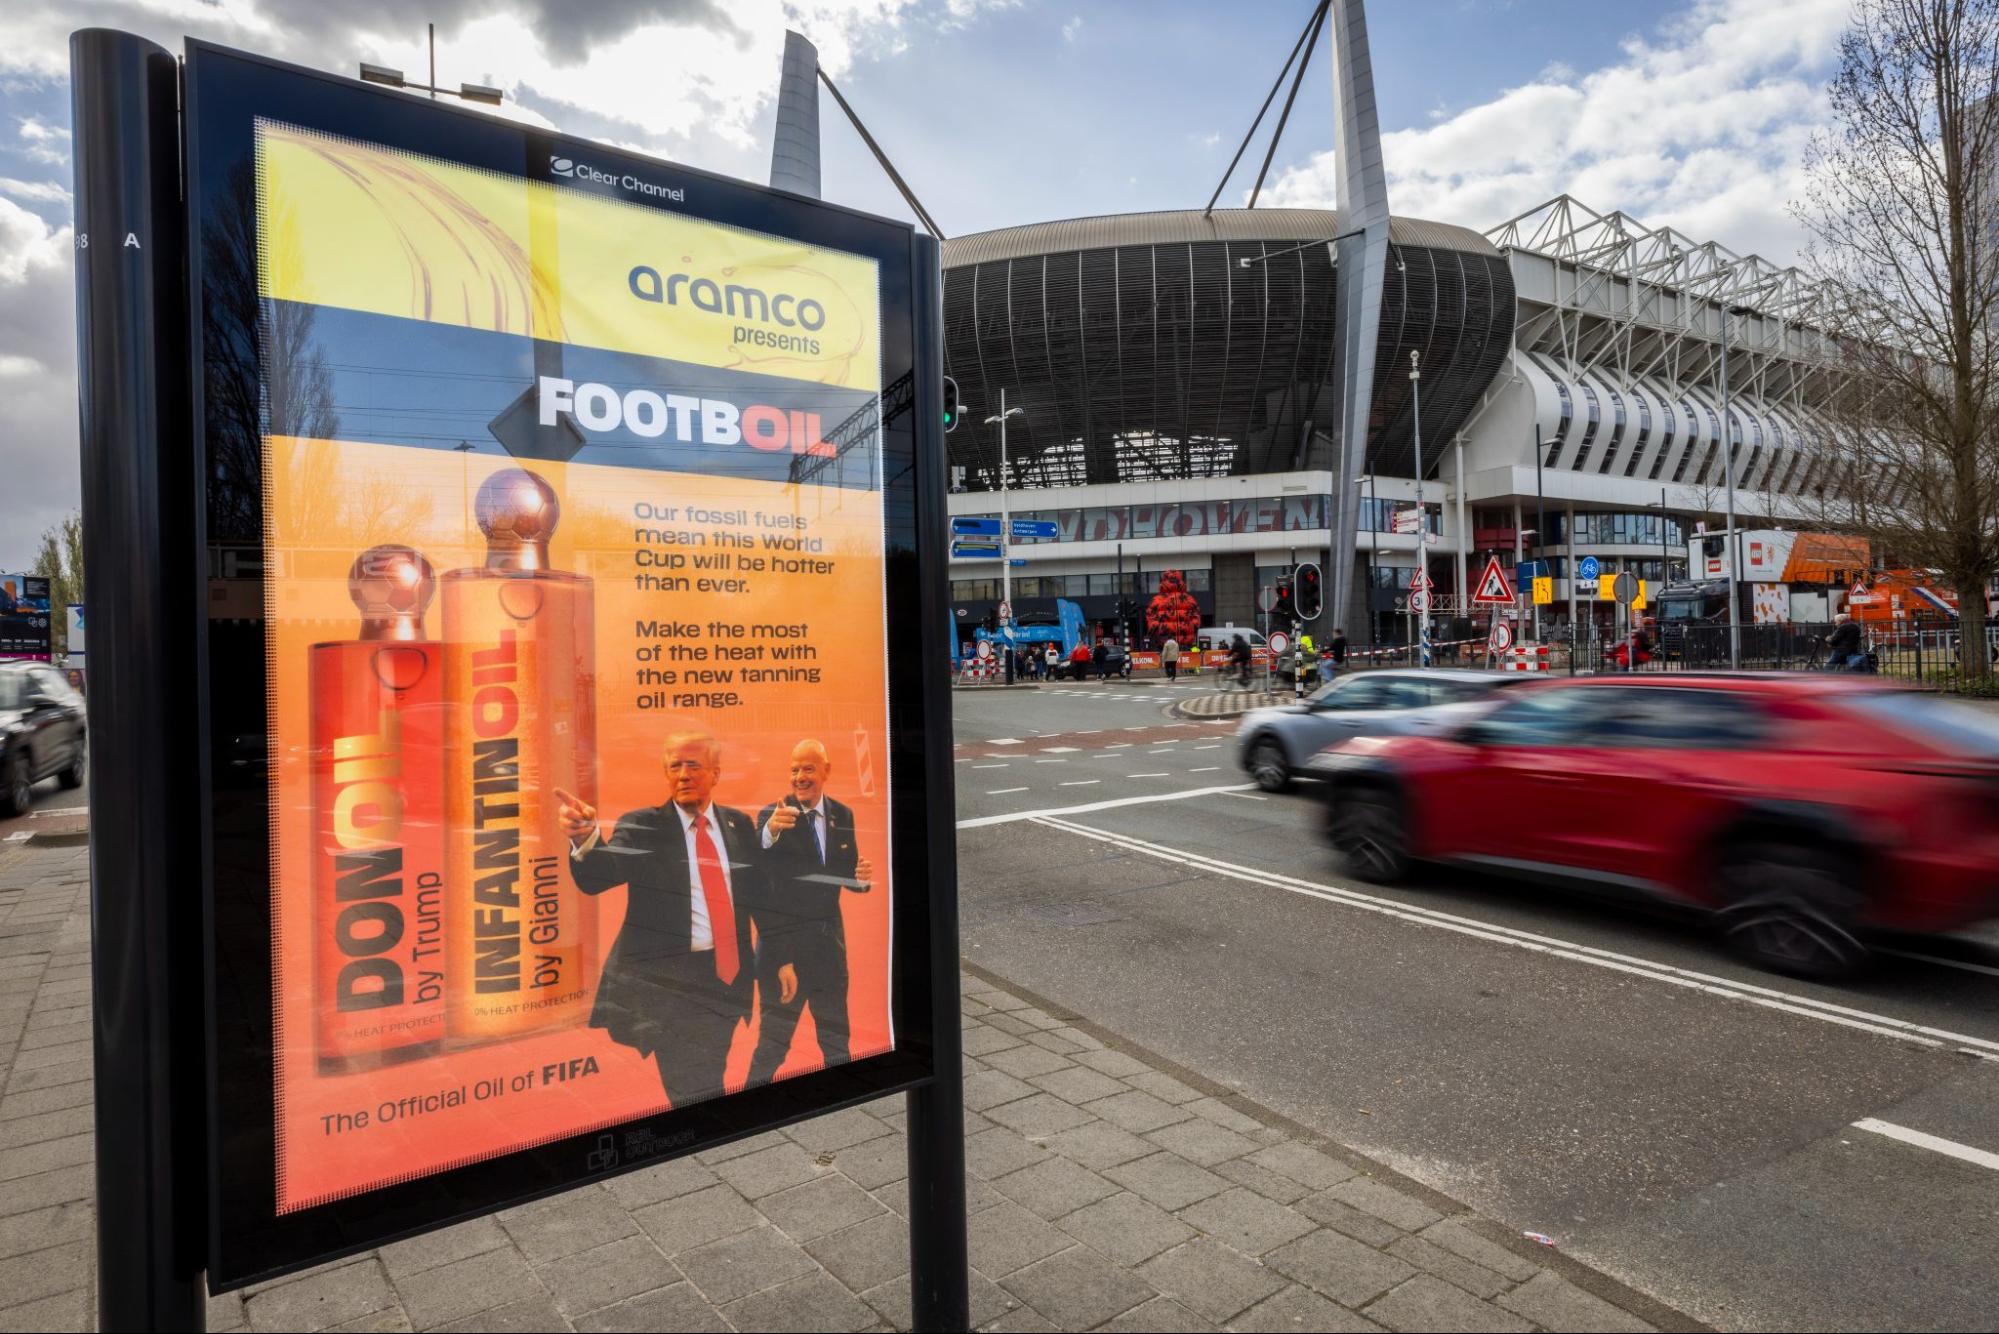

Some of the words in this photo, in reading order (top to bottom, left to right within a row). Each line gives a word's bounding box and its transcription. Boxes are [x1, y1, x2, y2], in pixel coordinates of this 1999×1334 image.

[576, 164, 619, 186] Clear
[622, 175, 685, 202] Channel
[123, 232, 141, 248] A
[628, 265, 826, 332] aramco
[733, 325, 821, 356] presents
[539, 375, 837, 458] FOOTBOIL
[634, 502, 678, 521] Our
[685, 506, 748, 526] fossil
[754, 511, 808, 530] fuels
[1022, 496, 1321, 542] NDHOVEN
[635, 528, 706, 546] mean
[712, 531, 754, 549] this
[762, 533, 823, 552] World
[635, 549, 685, 570] Cup
[693, 553, 730, 570] will
[737, 555, 765, 572] be
[772, 556, 835, 575] hotter
[634, 574, 690, 591] than
[696, 577, 750, 593] ever.
[635, 620, 701, 638] Make
[707, 621, 745, 638] the
[751, 623, 808, 638] most
[636, 644, 662, 662] of
[669, 644, 708, 661] the
[714, 644, 764, 661] heat
[771, 644, 817, 660] with
[636, 668, 677, 685] the
[684, 669, 733, 683] new
[740, 666, 821, 683] tanning
[636, 691, 665, 709] oil
[673, 691, 744, 708] range.
[472, 629, 521, 994] INFANTINOIL
[333, 708, 405, 1013] DONOIL
[529, 856, 559, 945] Gianni
[413, 872, 442, 962] Trump
[413, 971, 443, 1004] by
[530, 955, 562, 989] by
[490, 1003, 520, 1016] HEAT
[354, 1023, 385, 1037] HEAT
[320, 1110, 369, 1136] The
[377, 1085, 466, 1123] Official
[474, 1077, 503, 1101] Oil
[511, 1071, 535, 1092] of
[542, 1056, 599, 1085] FIFA
